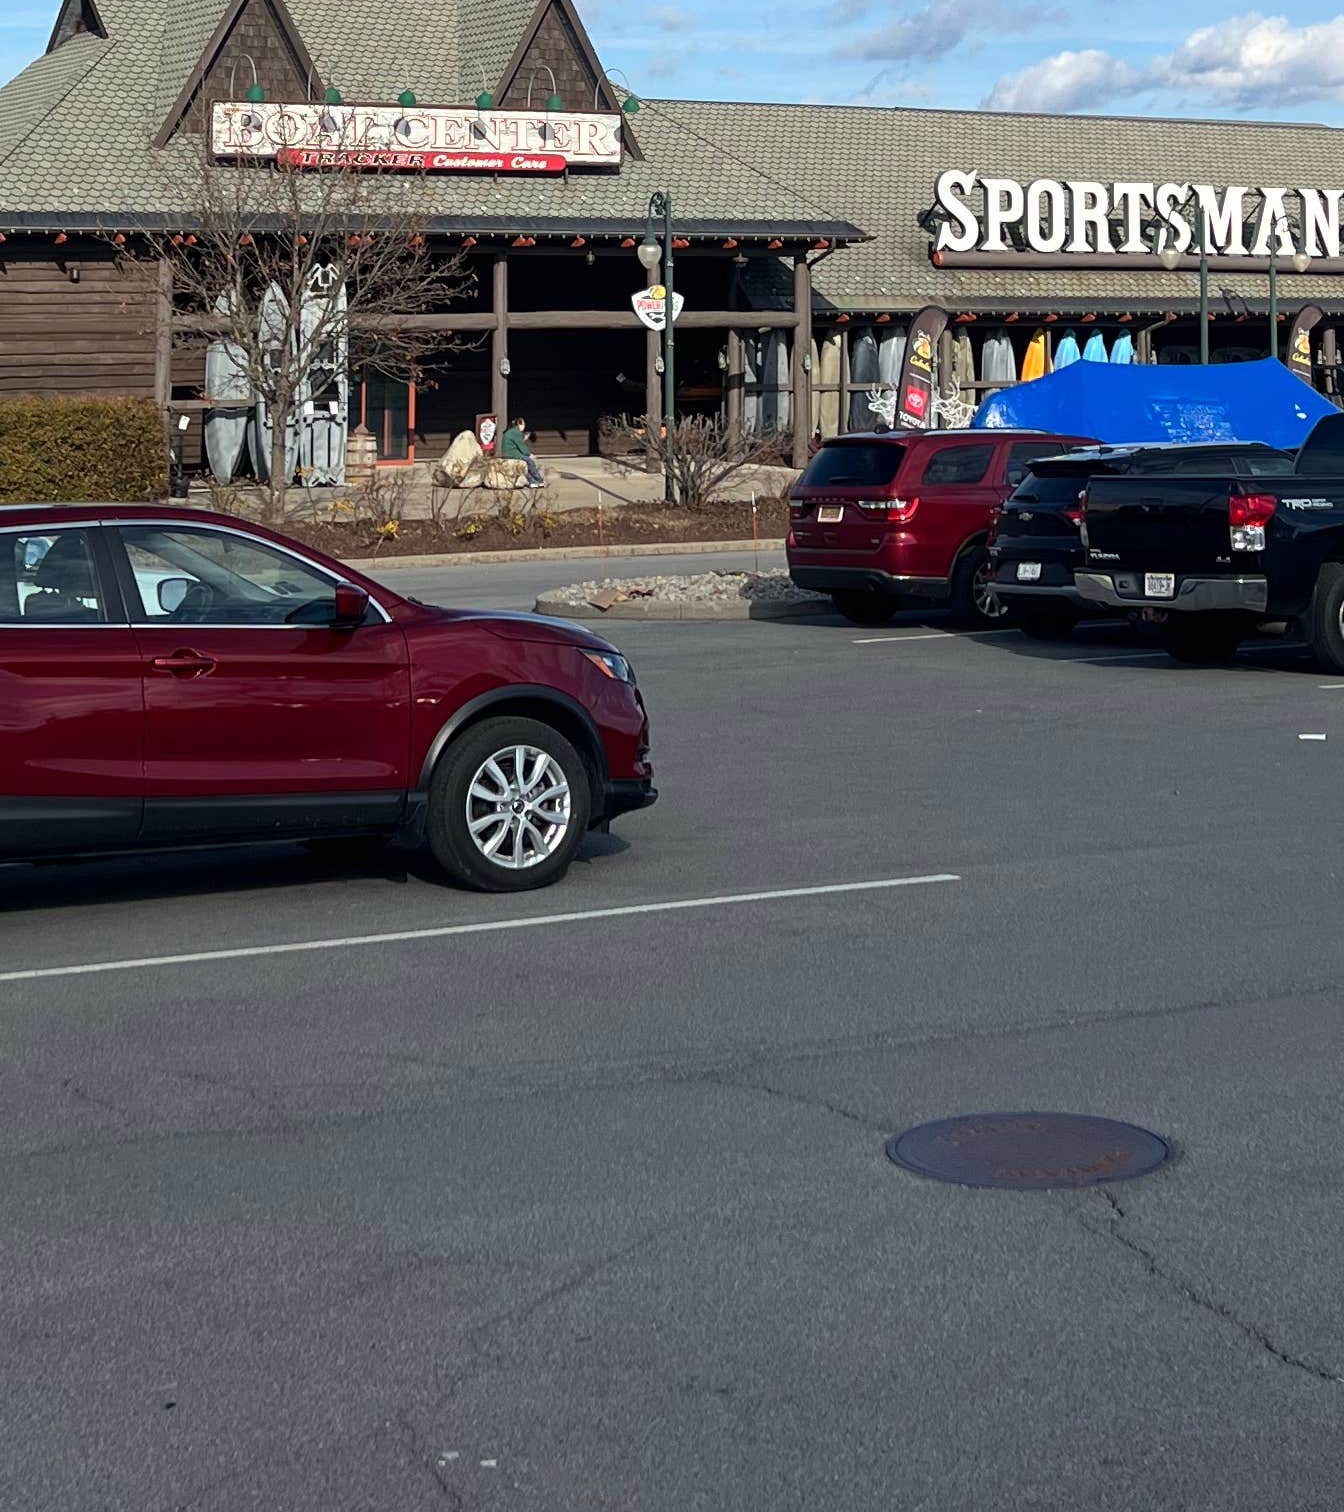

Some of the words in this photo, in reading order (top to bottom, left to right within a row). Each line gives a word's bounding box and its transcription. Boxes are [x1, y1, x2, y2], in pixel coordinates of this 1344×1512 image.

[223, 110, 377, 148] BOAT
[393, 112, 616, 156] CENTER
[301, 151, 425, 167] TRACKER
[432, 155, 504, 168] Customer
[510, 156, 547, 169] Care
[899, 410, 926, 429] TOYOTA
